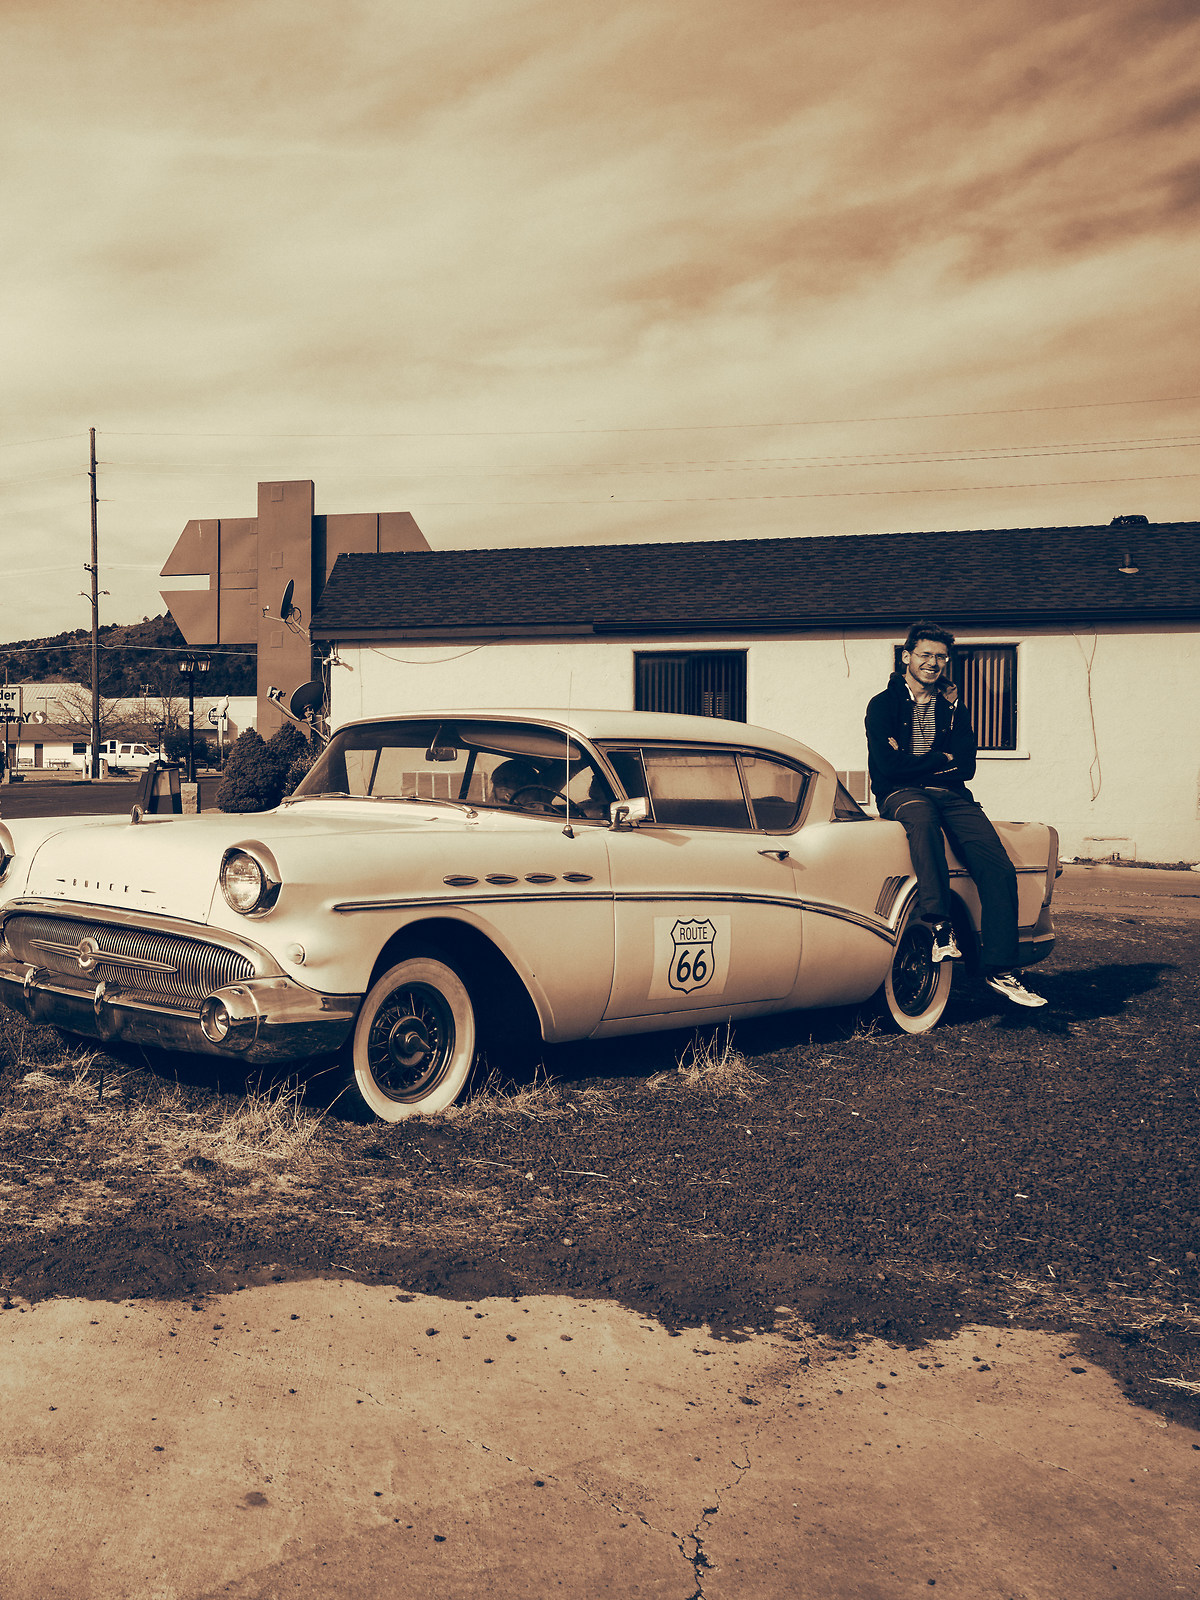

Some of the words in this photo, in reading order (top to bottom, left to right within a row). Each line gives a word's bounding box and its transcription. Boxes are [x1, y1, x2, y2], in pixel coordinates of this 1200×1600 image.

[72, 878, 129, 893] BUICK
[679, 926, 708, 940] ROUTE
[676, 948, 707, 983] 66
